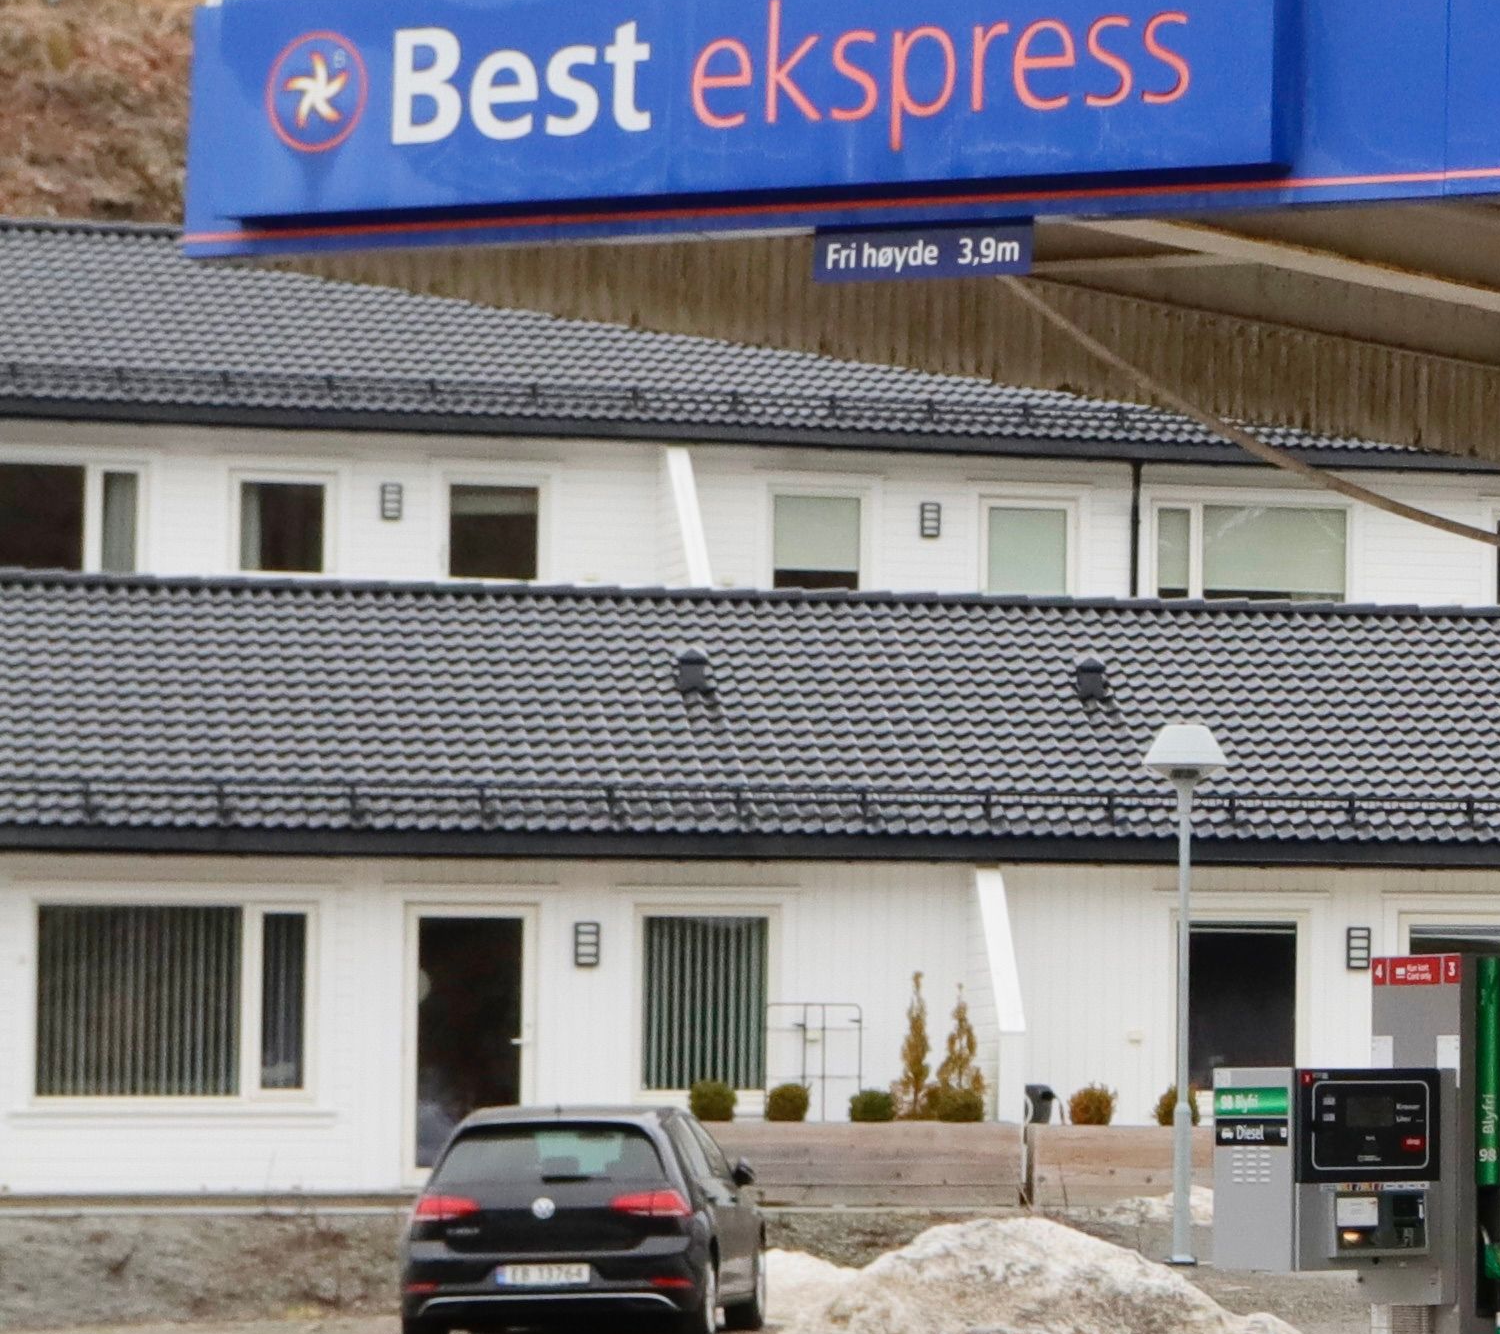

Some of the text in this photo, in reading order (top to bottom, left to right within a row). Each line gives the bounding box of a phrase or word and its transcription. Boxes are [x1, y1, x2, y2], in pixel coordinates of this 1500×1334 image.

[391, 21, 651, 145] Best
[826, 237, 1020, 273] Fri høyde 3,9m
[1375, 963, 1383, 978] 4
[1448, 961, 1456, 977] 3
[1236, 1124, 1264, 1140] Diesel
[1479, 1094, 1498, 1162] 98 Blyfri
